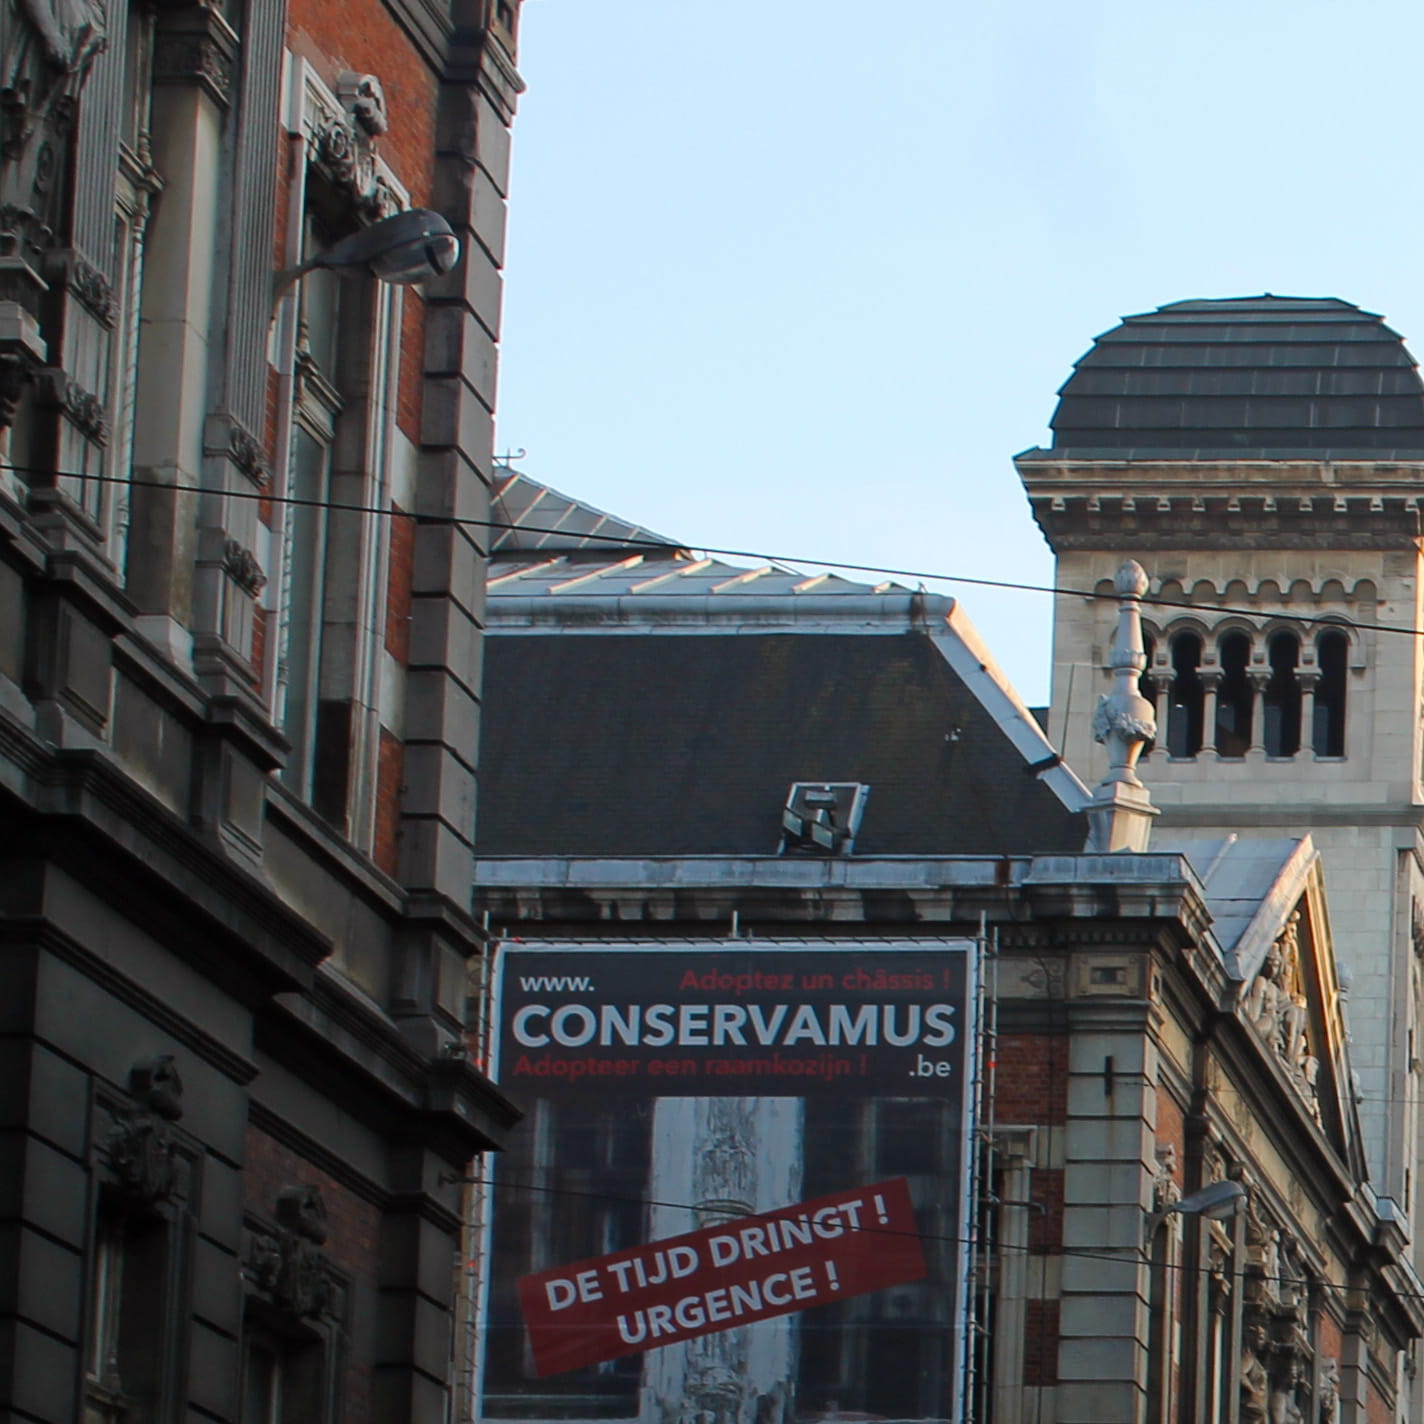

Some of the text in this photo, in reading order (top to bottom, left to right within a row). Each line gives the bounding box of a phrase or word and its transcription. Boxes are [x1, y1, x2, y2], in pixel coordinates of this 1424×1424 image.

[518, 975, 595, 991] www.
[680, 968, 793, 995] Adoptez
[802, 973, 834, 990] un
[842, 968, 935, 991] châssis
[511, 1003, 957, 1048] CONSERVAMUS
[511, 1054, 640, 1081] Adopteer
[647, 1059, 697, 1076] een
[705, 1053, 850, 1081] raamkozijn
[908, 1054, 952, 1078] .be
[544, 1194, 889, 1311] DE TIJD DRINGT !
[615, 1260, 840, 1344] URGENCE !
